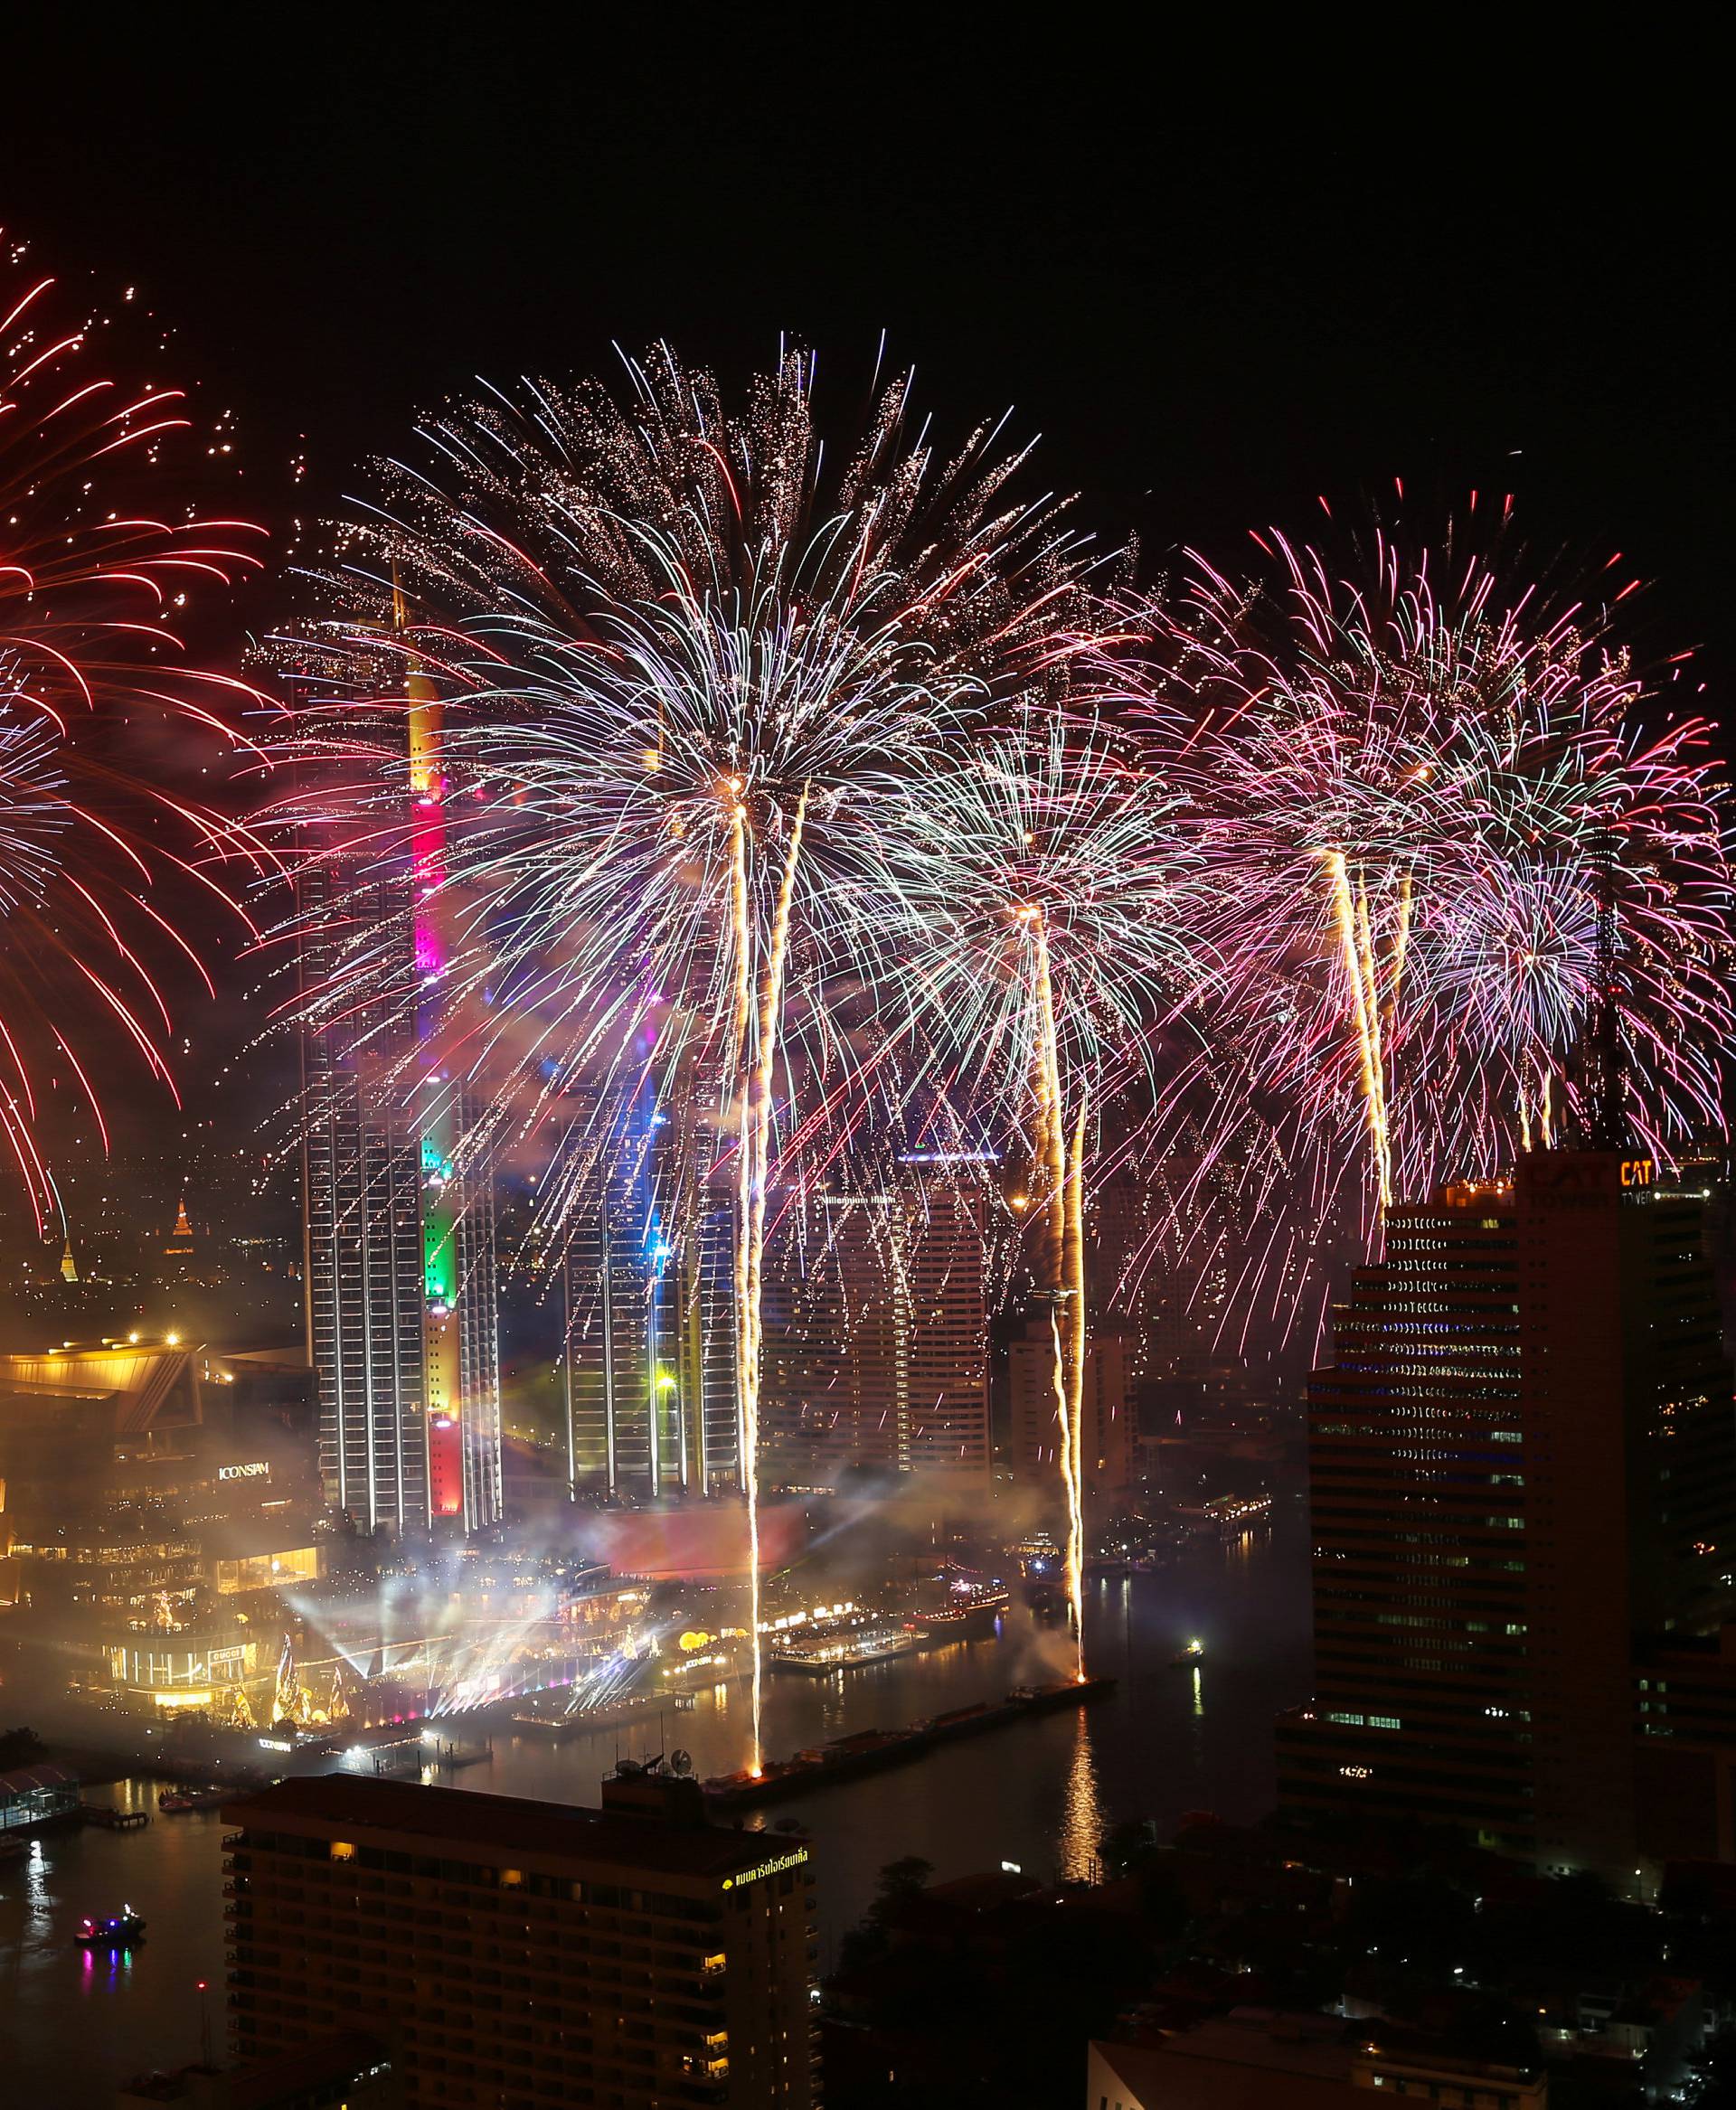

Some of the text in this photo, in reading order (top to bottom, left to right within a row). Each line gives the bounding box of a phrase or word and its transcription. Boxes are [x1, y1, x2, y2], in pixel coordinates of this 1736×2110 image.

[1621, 1160, 1652, 1186] CAT
[219, 1462, 269, 1481] ICONSIAM
[213, 1648, 240, 1661] GUCCI
